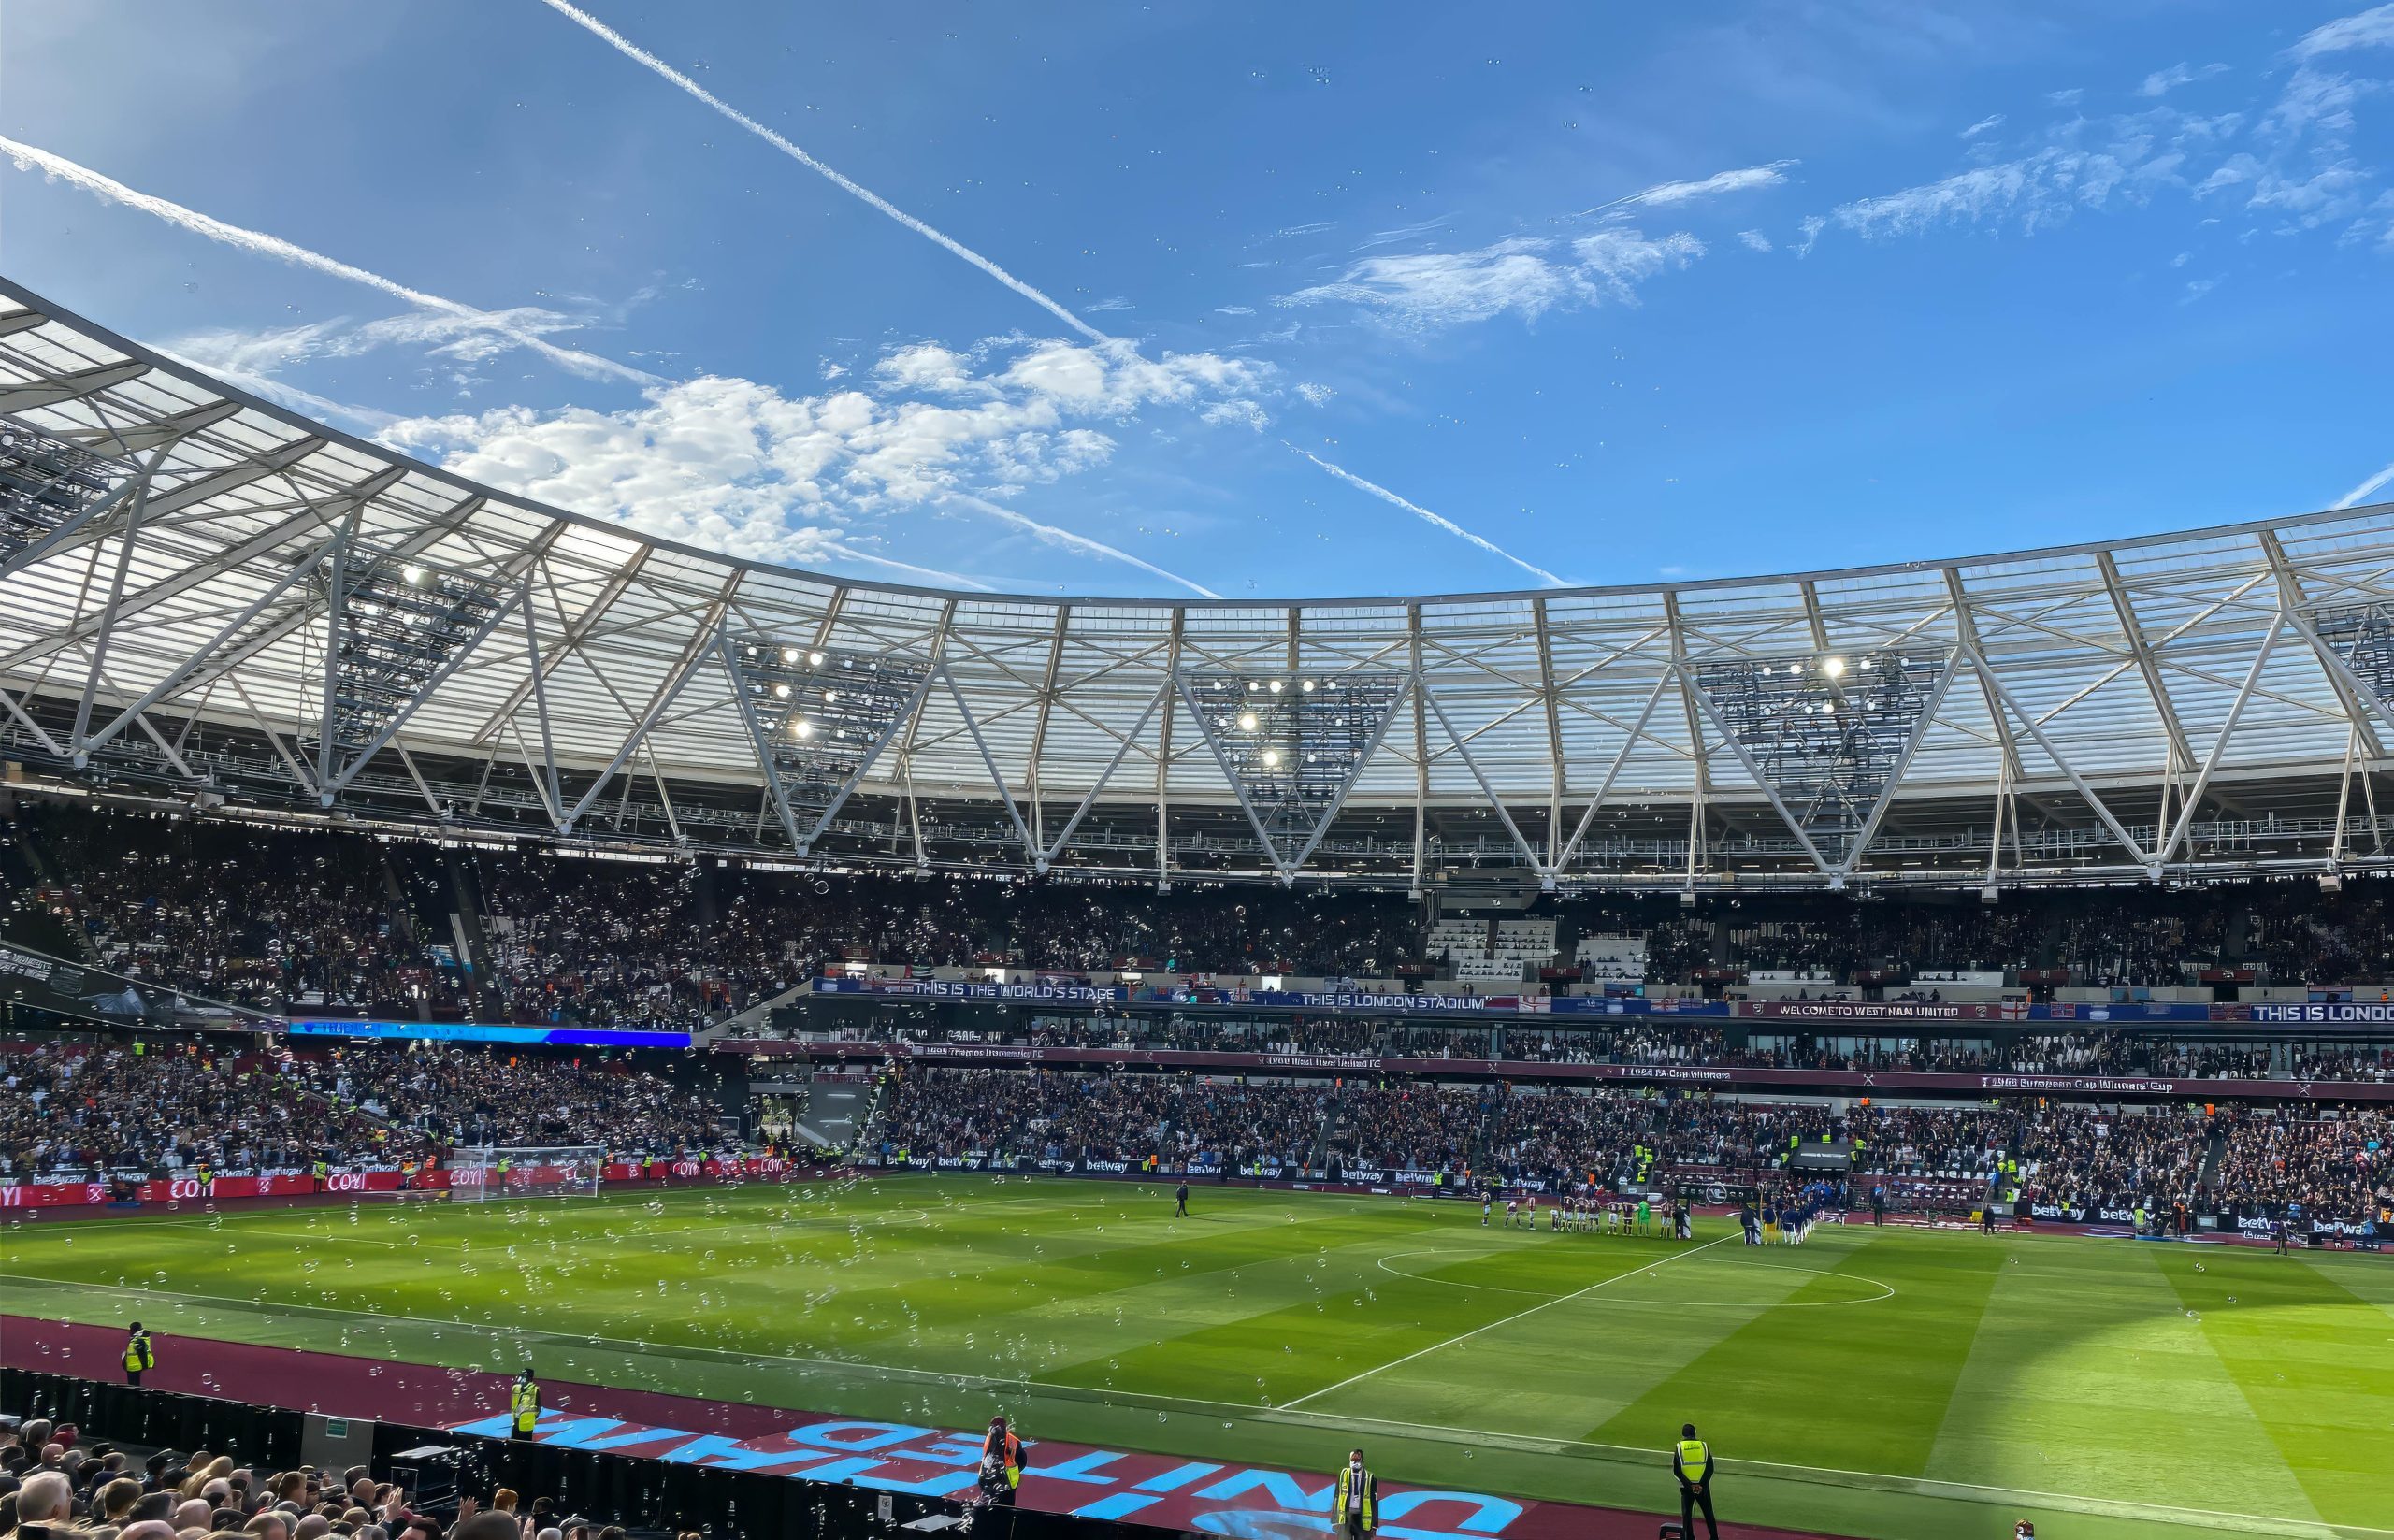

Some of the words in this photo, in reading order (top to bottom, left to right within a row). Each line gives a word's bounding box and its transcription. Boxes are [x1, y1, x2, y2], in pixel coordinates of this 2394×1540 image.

[915, 982, 947, 996] THIS
[951, 984, 964, 996] IS
[969, 985, 996, 997] THE
[1000, 986, 1065, 999] WORLD'S
[1068, 987, 1116, 1000] STAGE
[1302, 994, 1335, 1006] THIS
[1338, 995, 1350, 1006] IS
[1354, 996, 1415, 1008] LONDON
[1418, 997, 1485, 1010] STADIUM
[1781, 1005, 1839, 1015] WELCOME
[1839, 1007, 1852, 1015] TO
[1854, 1007, 1885, 1016] WEST
[1888, 1008, 1913, 1016] HAM
[1917, 1008, 1958, 1017] UNITED
[2254, 1006, 2300, 1021] THIS
[2306, 1007, 2324, 1021] IS
[2020, 1079, 2072, 1089] European
[2075, 1080, 2097, 1090] Cup
[2151, 1082, 2173, 1093] Cup
[887, 1155, 930, 1169] bway
[1087, 1159, 1128, 1173] betway
[1240, 1164, 1283, 1179] beway
[1341, 1169, 1384, 1184] betway
[1395, 1171, 1437, 1185] betwa
[170, 1180, 215, 1199] COI
[1502, 1176, 1546, 1192] btway
[0, 1186, 22, 1207] YI
[2100, 1207, 2156, 1222] betw
[2314, 1220, 2376, 1235] betwa
[788, 1421, 1523, 1534] UNITED
